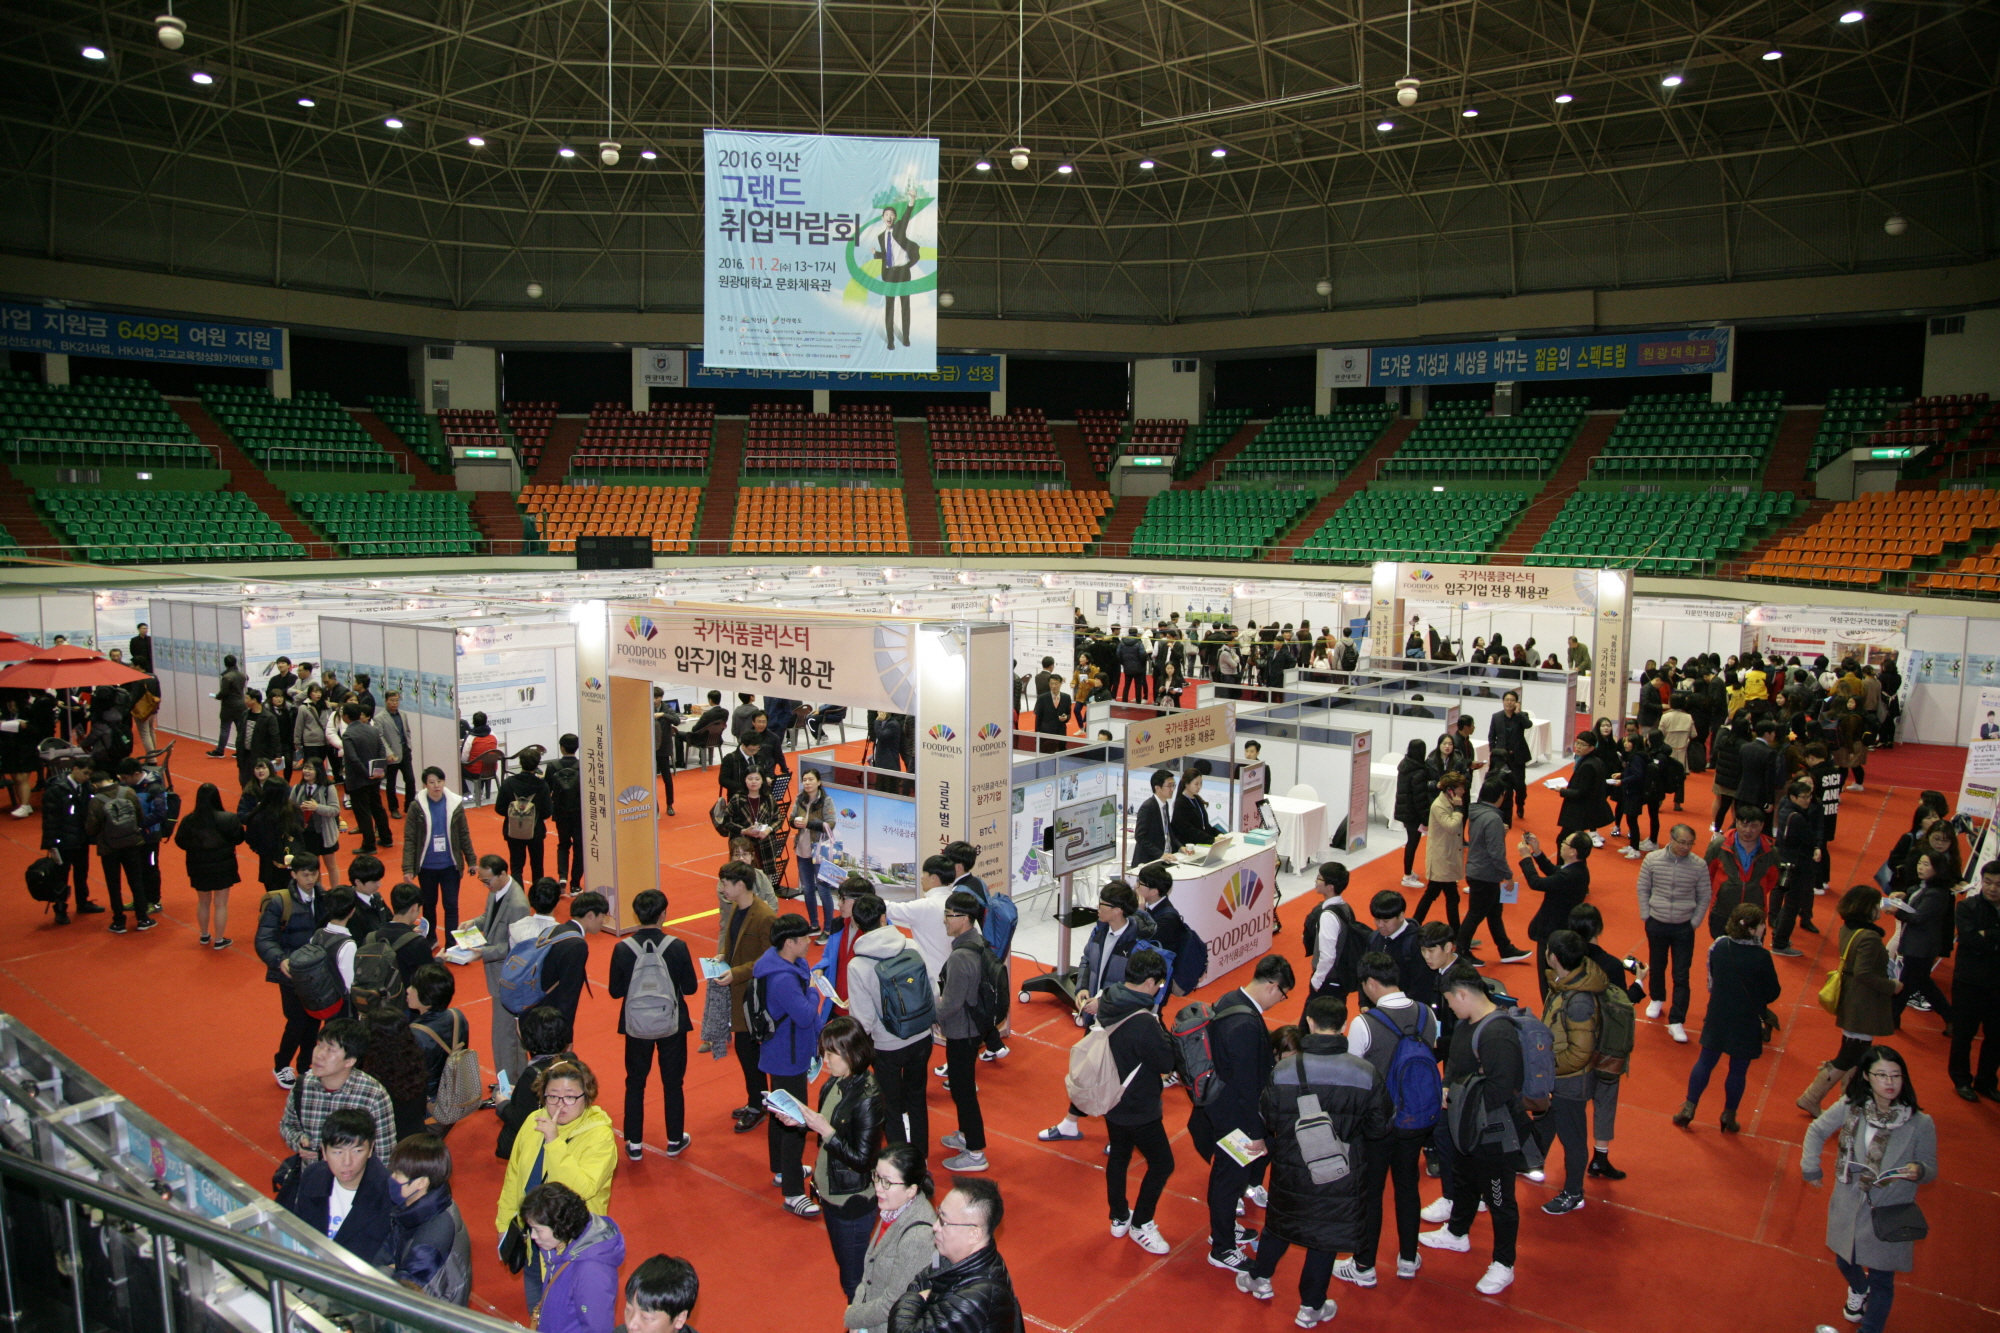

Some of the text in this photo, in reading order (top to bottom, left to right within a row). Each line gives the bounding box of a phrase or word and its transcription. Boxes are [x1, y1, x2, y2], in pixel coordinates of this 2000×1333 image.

[719, 150, 801, 172] 2016 익산
[719, 175, 805, 208] 그랜드
[719, 209, 860, 247] 취업박람회
[719, 257, 745, 270] 2016.
[795, 261, 836, 274] 13~17시
[719, 275, 832, 292] 원광대학교 문화체육관
[43, 313, 108, 338] 지원금
[118, 320, 179, 344] 649억
[189, 327, 227, 348] 여원
[235, 331, 271, 351] 지원
[61, 341, 114, 355] BK21사업,
[1643, 345, 1711, 361] 원광대학교
[1379, 343, 1627, 377] 뜨거운 지성과 세상을 바꾸는 젊음의 스펙트럼
[644, 374, 679, 382] 원광대학교
[967, 366, 994, 381] 선정
[1459, 569, 1535, 584] 국가식품클러스터
[1403, 582, 1439, 590] FOODPOLIS
[1445, 582, 1549, 600] 입주기업 전용 채용관
[693, 618, 810, 651] 국가식품클러스터
[616, 643, 667, 660] FOODPOLIS
[674, 645, 836, 690] 입주기업 전용 채용관
[1598, 647, 1609, 708] 국가식품클러스터
[1609, 671, 1616, 684] 미래
[582, 691, 606, 700] FOODPOLIS
[1165, 715, 1211, 736] 국가식품클러스터
[922, 741, 962, 755] FOODPOLIS
[972, 740, 1007, 754] FOODPOLIS
[1158, 729, 1216, 754] 입주기업 전용 채용관
[596, 724, 607, 819] 식품산업의 미래
[971, 778, 1008, 794] 국가식품클러스터
[587, 748, 600, 862] 국가식품클러스터
[939, 780, 950, 828] 글로벌
[976, 790, 1002, 806] 참가기업
[617, 804, 651, 816] FOODPOLIS
[979, 826, 993, 837] BTC
[1206, 909, 1271, 957] FOODPOLIS
[1218, 938, 1259, 968] 국가식품클러스터
